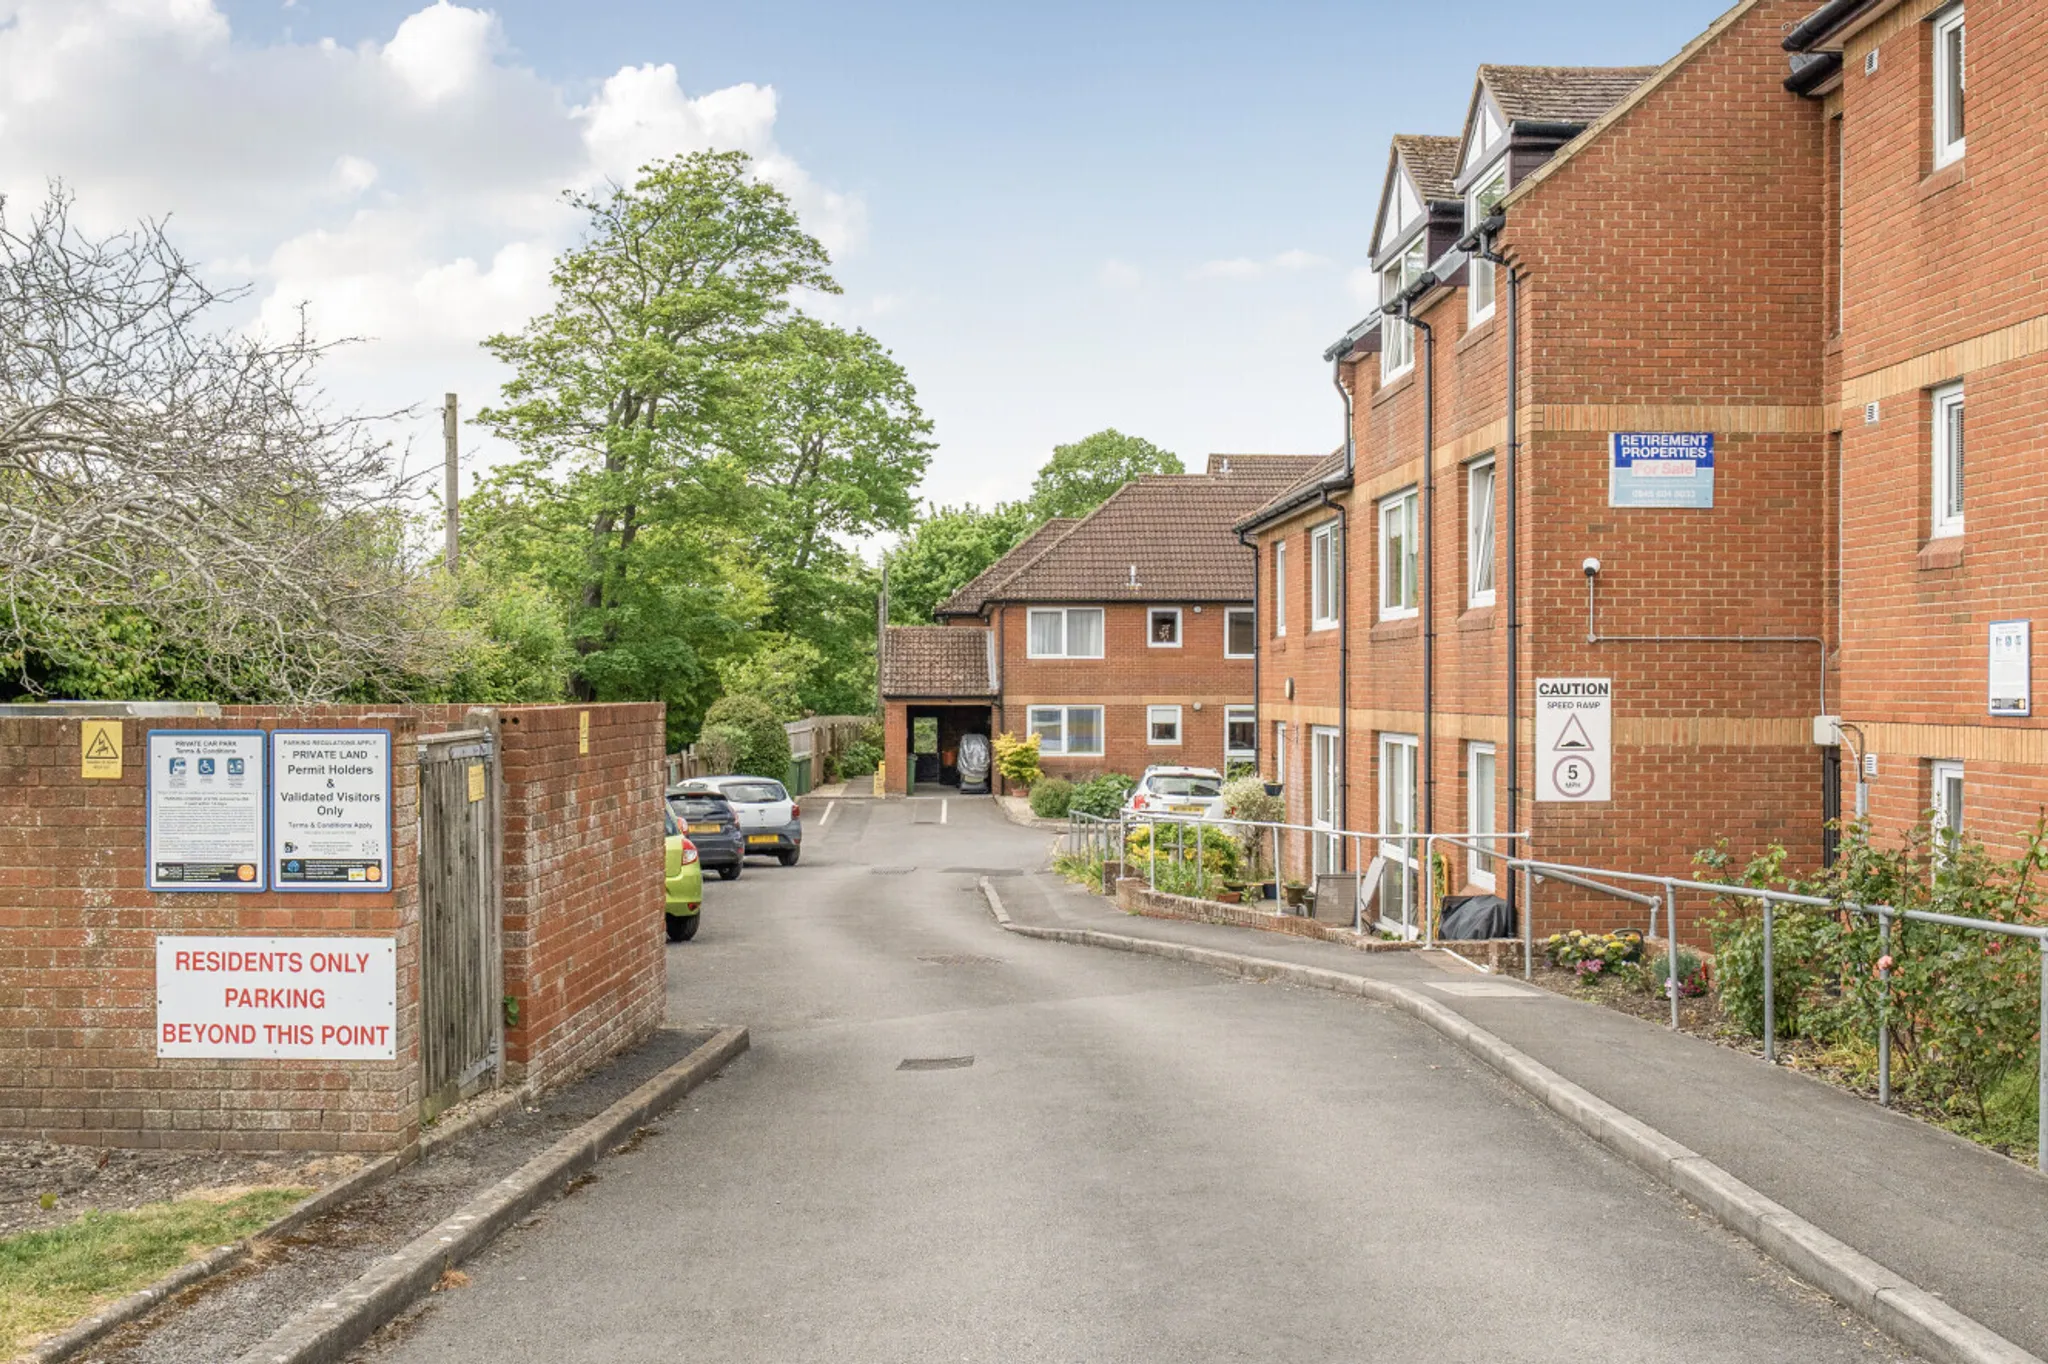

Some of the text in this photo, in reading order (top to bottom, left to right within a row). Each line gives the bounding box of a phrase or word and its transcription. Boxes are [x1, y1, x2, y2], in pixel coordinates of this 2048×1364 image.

[1621, 434, 1708, 446] RETIREMENT
[1622, 447, 1707, 458] PROPERTIES
[1633, 462, 1693, 475] For Sale
[1539, 683, 1609, 695] CAUTION
[1547, 701, 1601, 709] SPEED RAMP
[292, 750, 368, 760] PRIVATE LAND
[287, 764, 374, 775] Permit Holders
[1568, 764, 1578, 780] 5
[326, 778, 335, 789] &
[280, 792, 381, 803] Validated Visitors
[316, 805, 344, 818] Only
[288, 821, 308, 829] Terms
[354, 822, 373, 830] Apply
[175, 951, 370, 974] RESIDENTS ONLY
[225, 987, 326, 1009] PARKING
[162, 1022, 390, 1046] BEYOND THIS POINT
